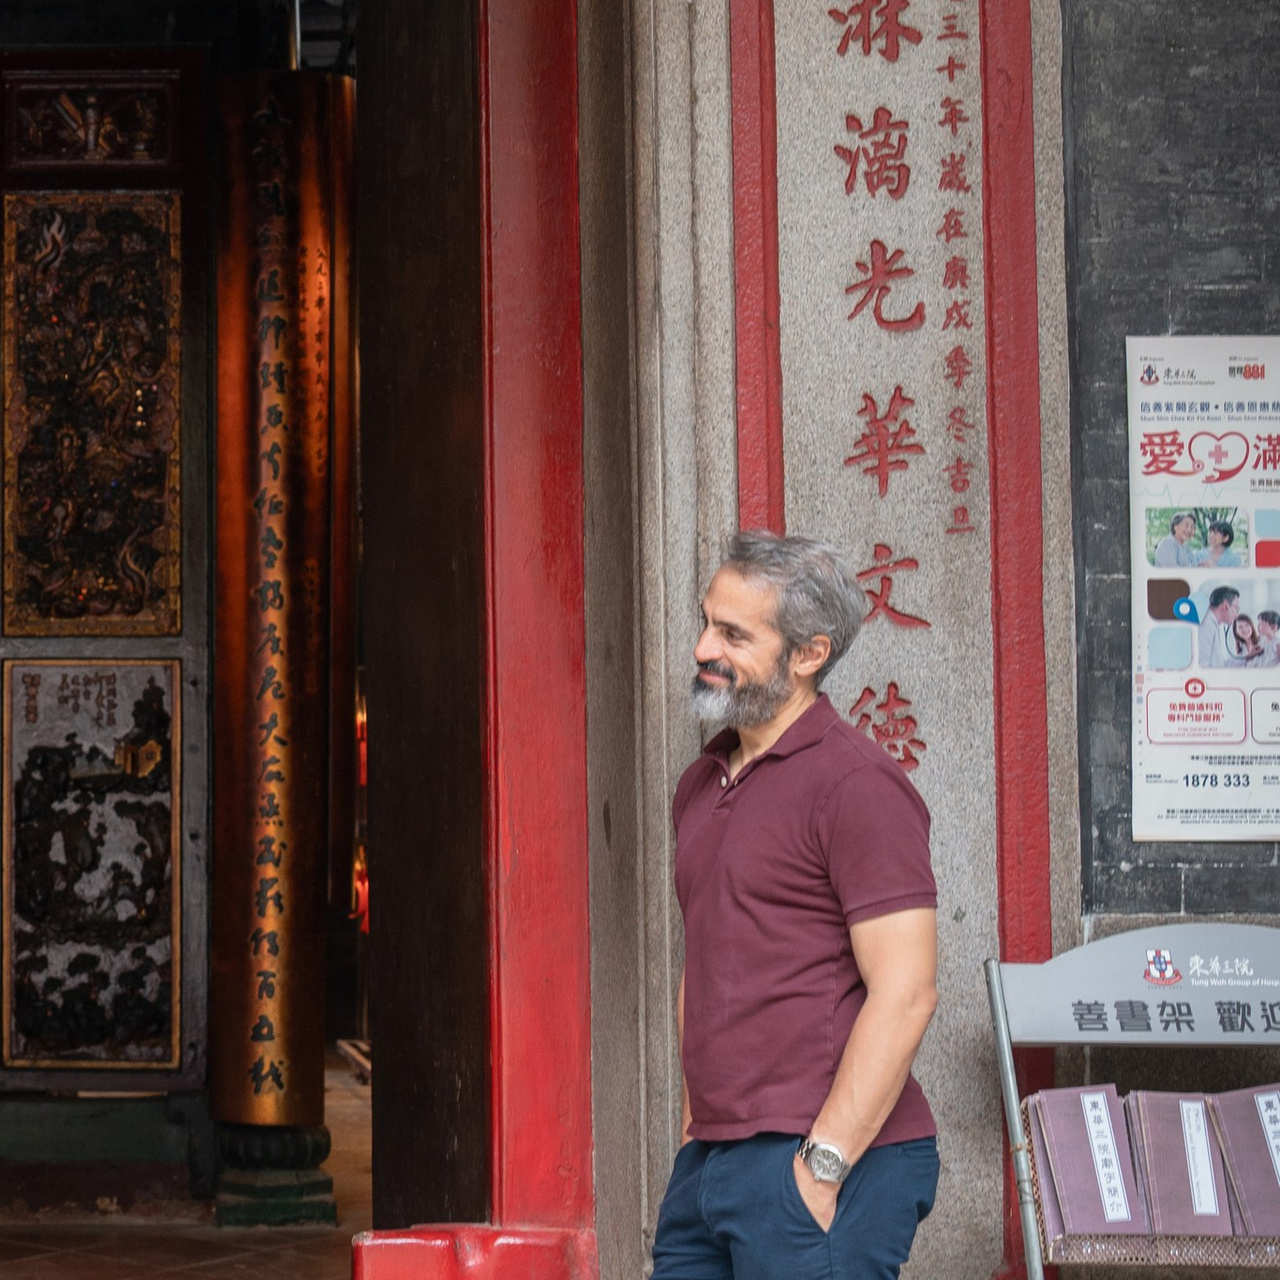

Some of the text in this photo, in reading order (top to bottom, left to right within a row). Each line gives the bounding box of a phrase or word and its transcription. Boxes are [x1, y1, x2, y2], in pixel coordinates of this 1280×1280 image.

[1183, 774, 1218, 787] 1878
[1223, 774, 1250, 787] 333
[1191, 978, 1209, 987] Tung
[1210, 978, 1227, 986] Wah
[1227, 978, 1251, 987] Group
[1251, 978, 1260, 986] of
